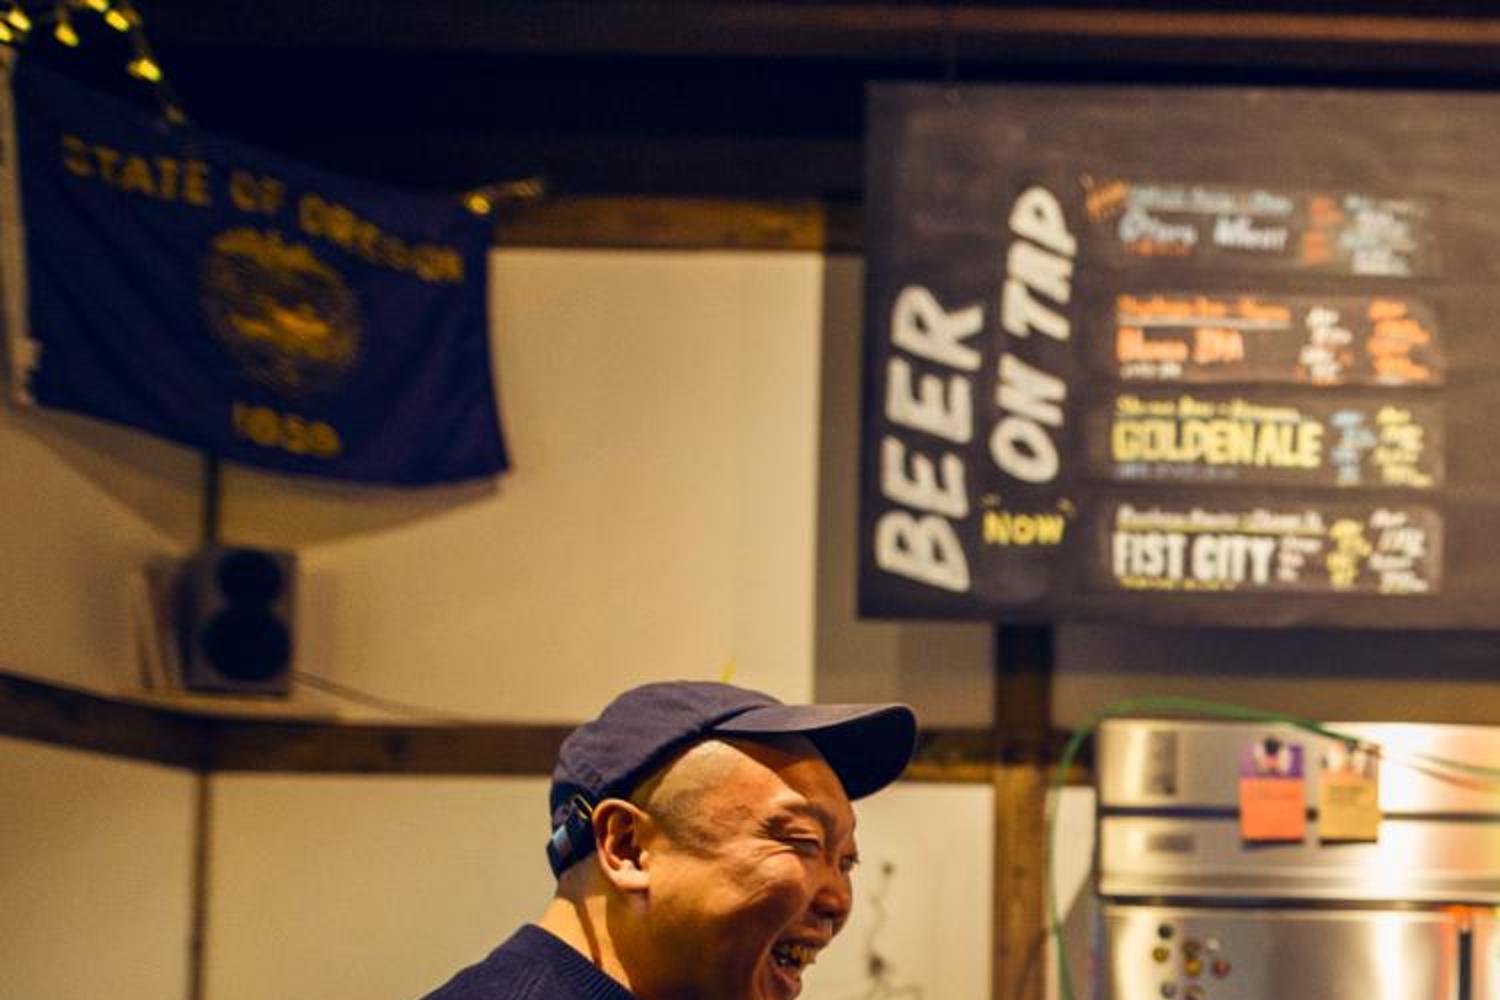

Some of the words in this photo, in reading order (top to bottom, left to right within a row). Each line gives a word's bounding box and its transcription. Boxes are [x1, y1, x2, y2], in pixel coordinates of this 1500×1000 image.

[62, 133, 212, 207] STATE
[1002, 186, 1078, 341] TAP
[875, 285, 984, 593] BEER
[989, 352, 1067, 484] ON
[1112, 410, 1255, 463] GOLDEN
[1255, 413, 1325, 467] ALE
[1112, 530, 1188, 579] FIST
[1191, 532, 1275, 584] CITY
